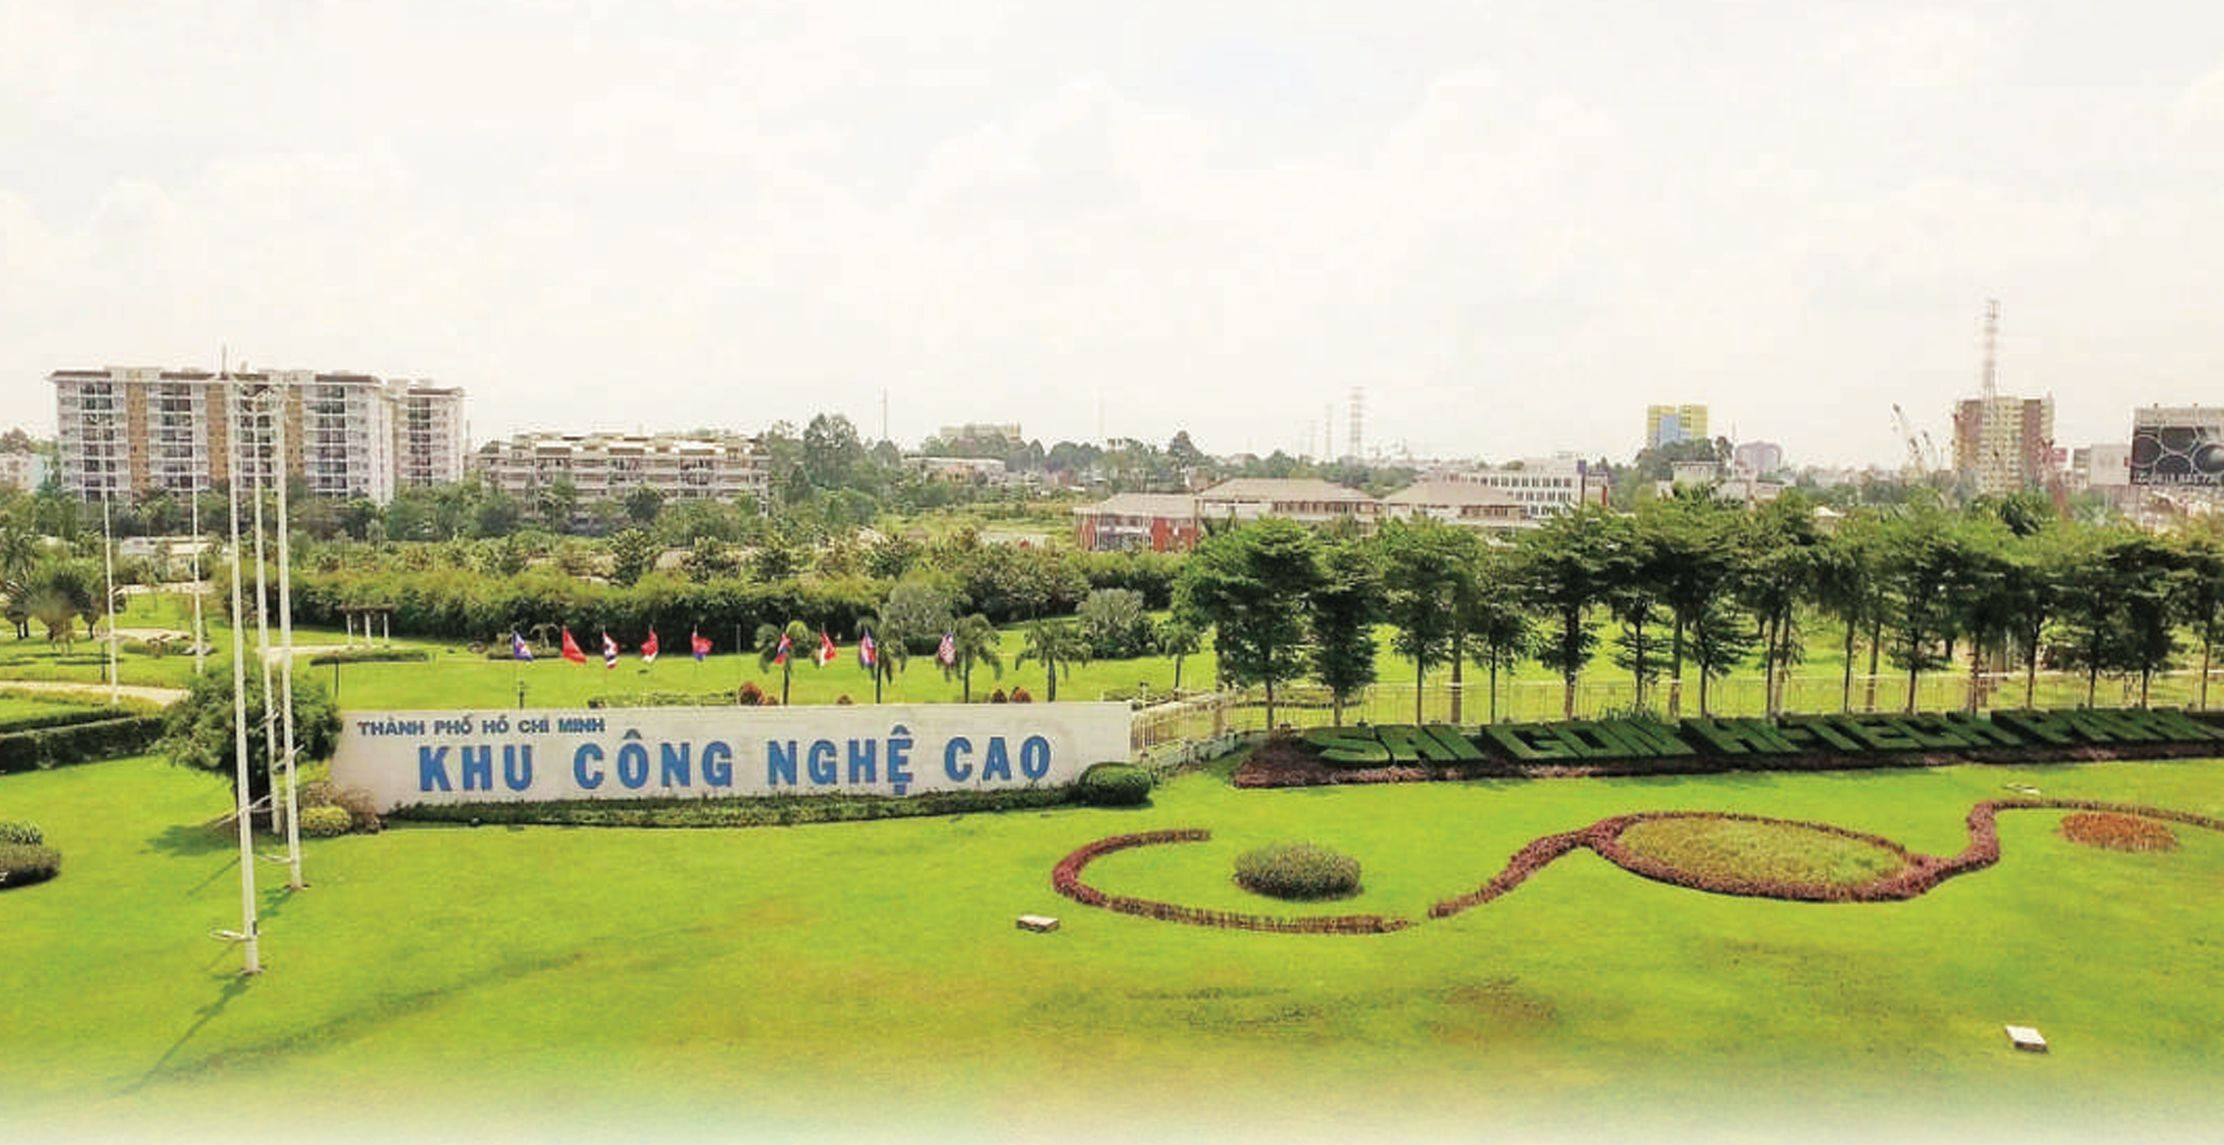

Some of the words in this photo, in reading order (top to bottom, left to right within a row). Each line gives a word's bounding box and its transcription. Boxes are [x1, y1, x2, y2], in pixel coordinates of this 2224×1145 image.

[357, 716, 425, 736] THÀNH
[434, 713, 474, 735] PHỐ
[558, 717, 606, 733] MINH
[1301, 724, 1487, 764] SAI
[1482, 718, 1692, 760] GON
[418, 744, 533, 791] KHU
[573, 728, 732, 790] CÔNG
[768, 724, 913, 795] NGHỆ
[944, 735, 1050, 781] CAO
